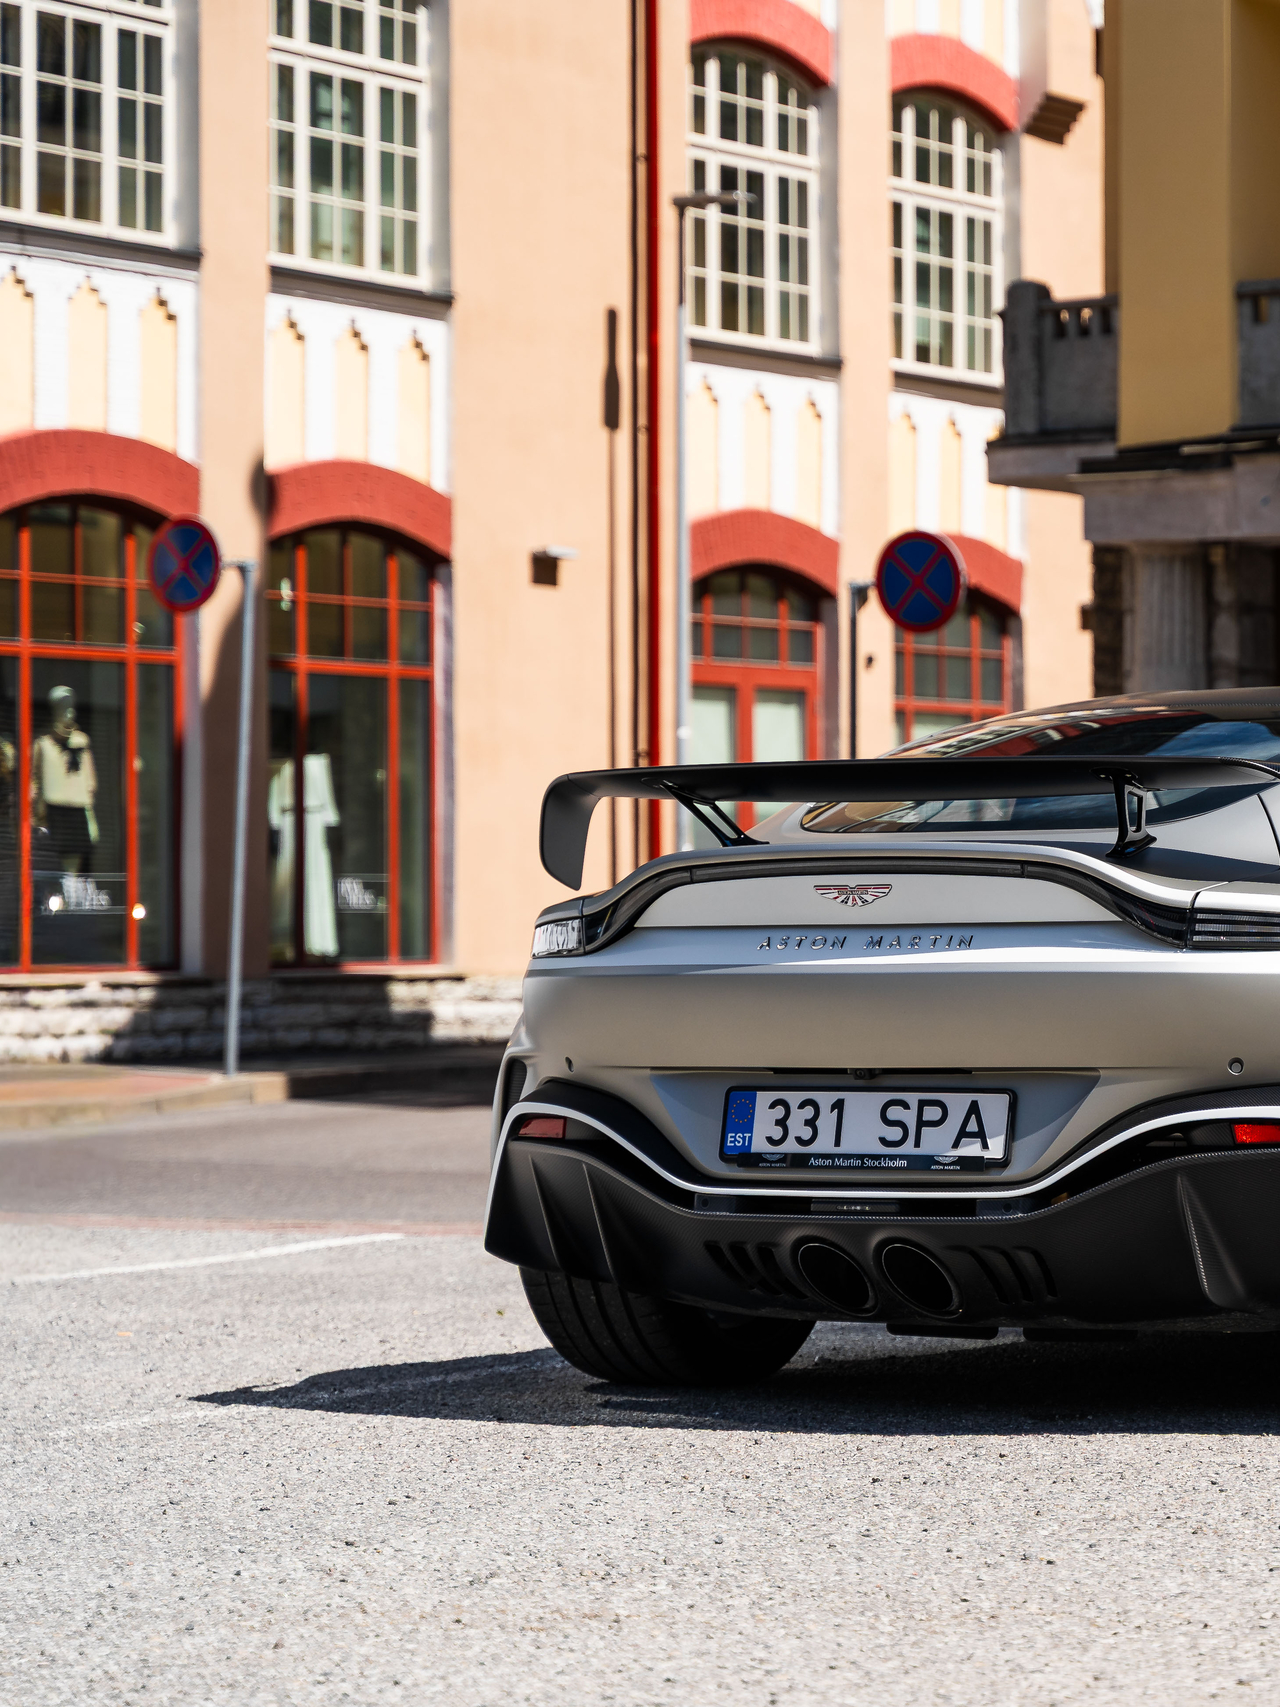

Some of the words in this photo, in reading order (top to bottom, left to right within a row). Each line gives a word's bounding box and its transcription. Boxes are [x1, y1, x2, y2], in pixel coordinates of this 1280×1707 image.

[757, 935, 847, 950] ASTON
[863, 935, 974, 949] MARTIN
[765, 1097, 846, 1148] 331
[878, 1098, 990, 1151] SPA
[727, 1133, 751, 1146] EST
[808, 1157, 831, 1167] Aston
[833, 1157, 862, 1168] Martin
[863, 1157, 907, 1168] Stockholm
